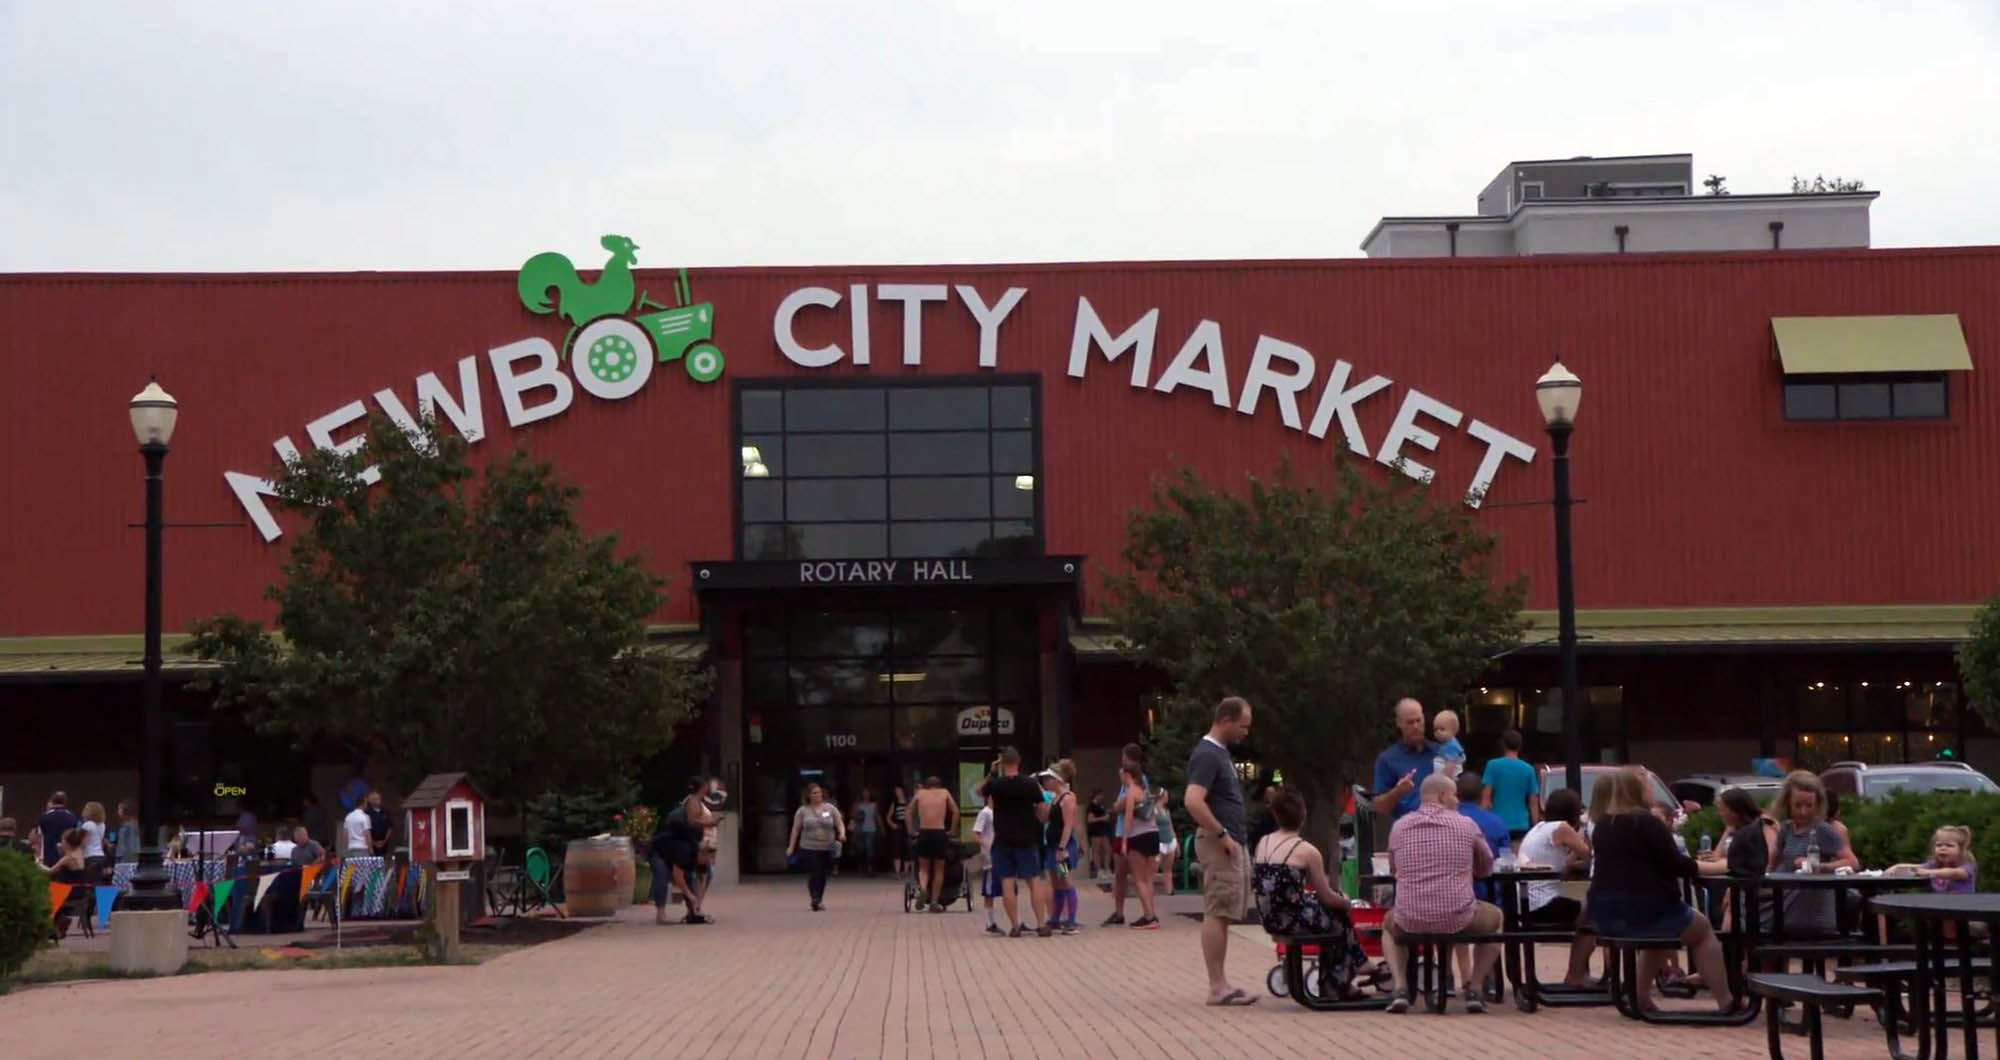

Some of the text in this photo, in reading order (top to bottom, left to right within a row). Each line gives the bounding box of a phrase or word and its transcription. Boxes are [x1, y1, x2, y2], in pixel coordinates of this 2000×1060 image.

[774, 284, 1028, 367] CITY
[1067, 296, 1536, 509] MARKET
[800, 560, 972, 583] ROTARY HALL
[824, 734, 857, 748] 1100
[214, 785, 247, 797] OPEN
